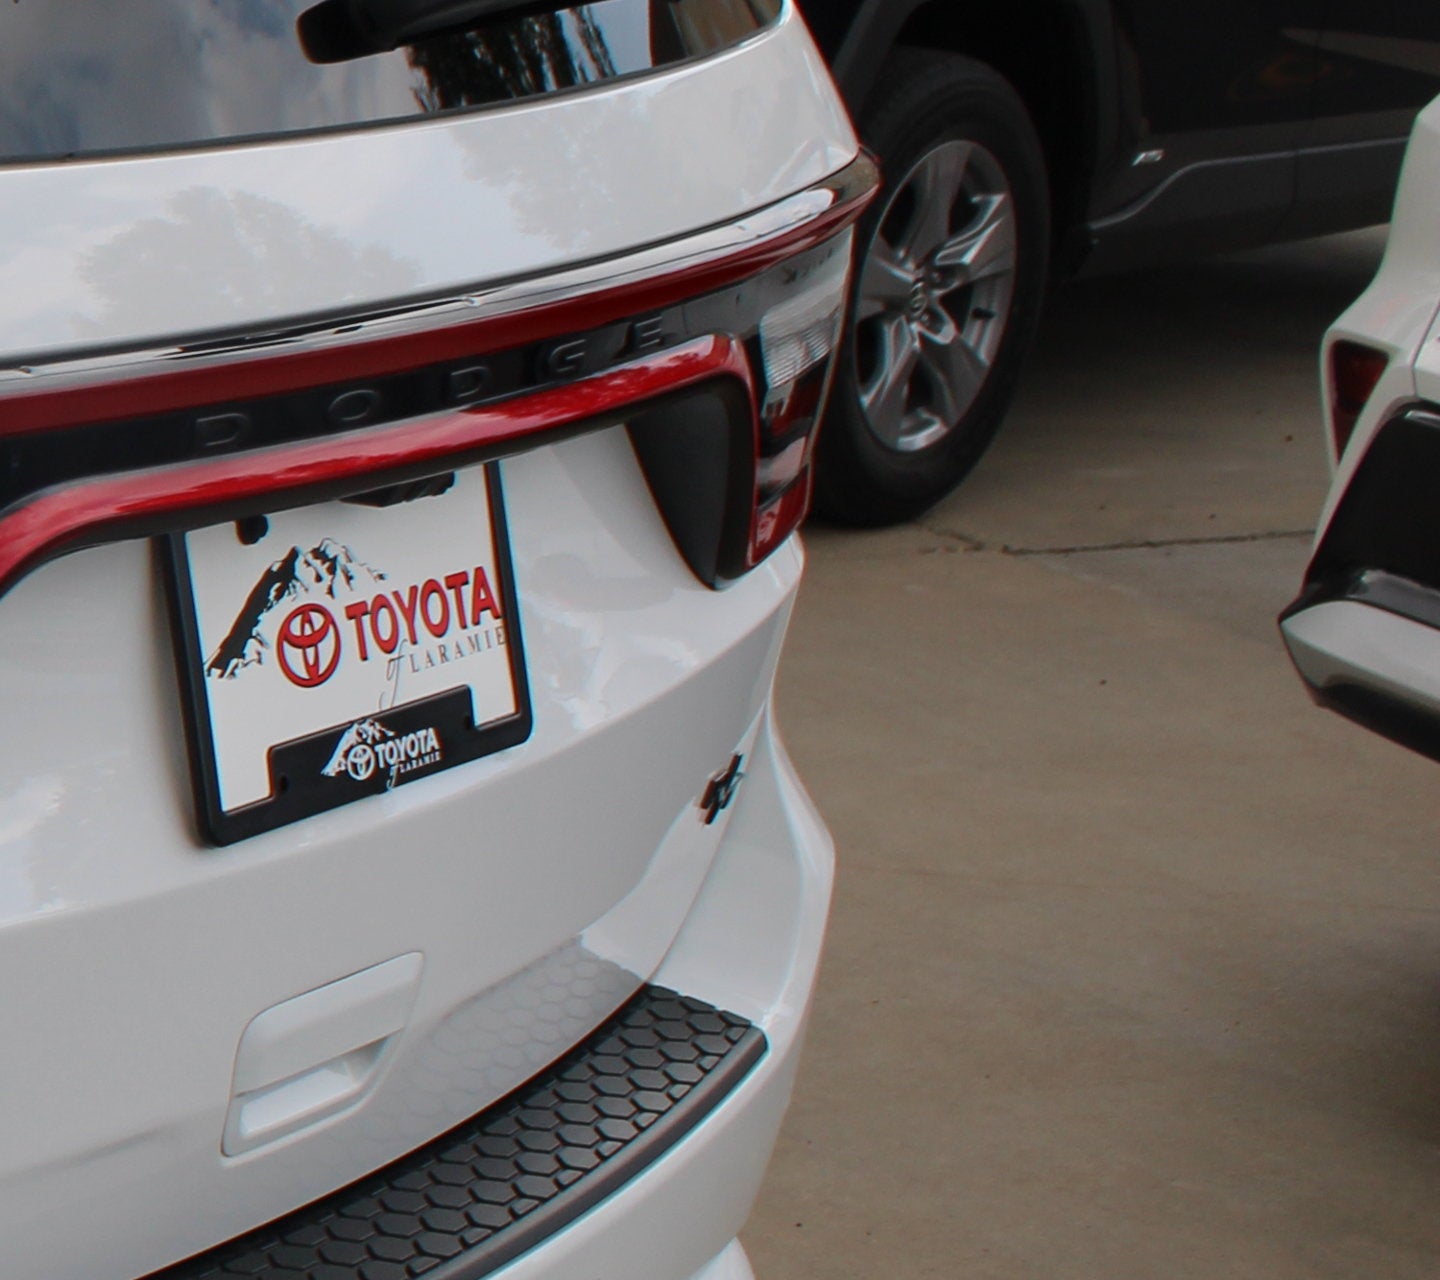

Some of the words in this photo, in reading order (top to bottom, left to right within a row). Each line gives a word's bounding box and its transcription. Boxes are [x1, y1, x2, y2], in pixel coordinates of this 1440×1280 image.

[195, 316, 665, 449] DODGE
[344, 565, 503, 662] TOYOTA
[409, 625, 508, 673] LARAMIE
[374, 727, 440, 768] TOYOTA
[400, 752, 441, 773] LARAMIE
